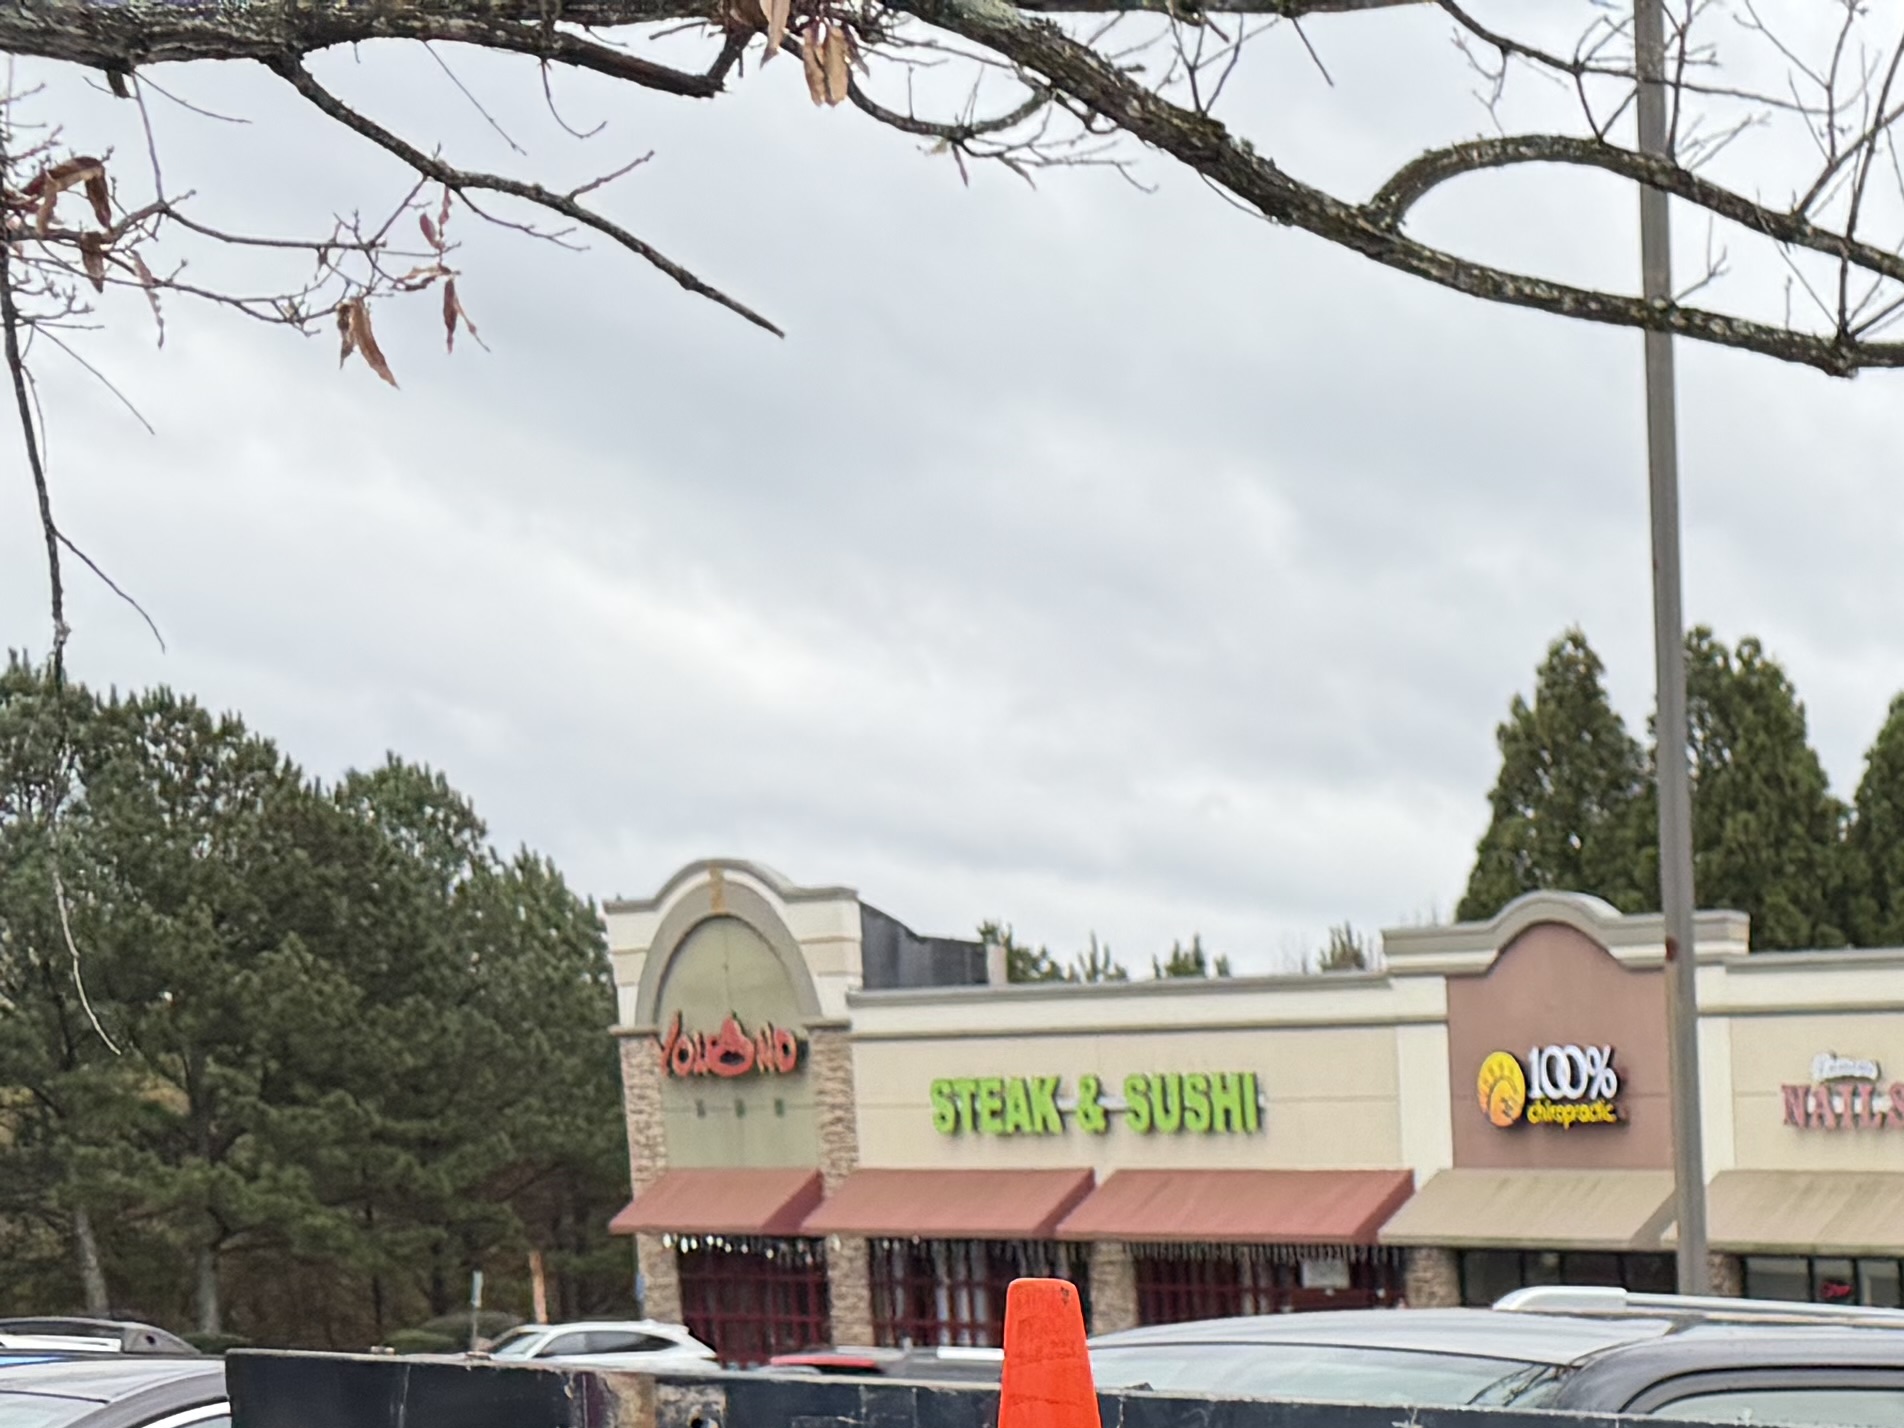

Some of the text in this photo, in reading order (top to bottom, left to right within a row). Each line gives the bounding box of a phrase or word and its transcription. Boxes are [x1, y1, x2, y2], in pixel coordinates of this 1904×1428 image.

[1528, 1044, 1618, 1100] 100%
[930, 1071, 1259, 1135] STEAK & SUSHI
